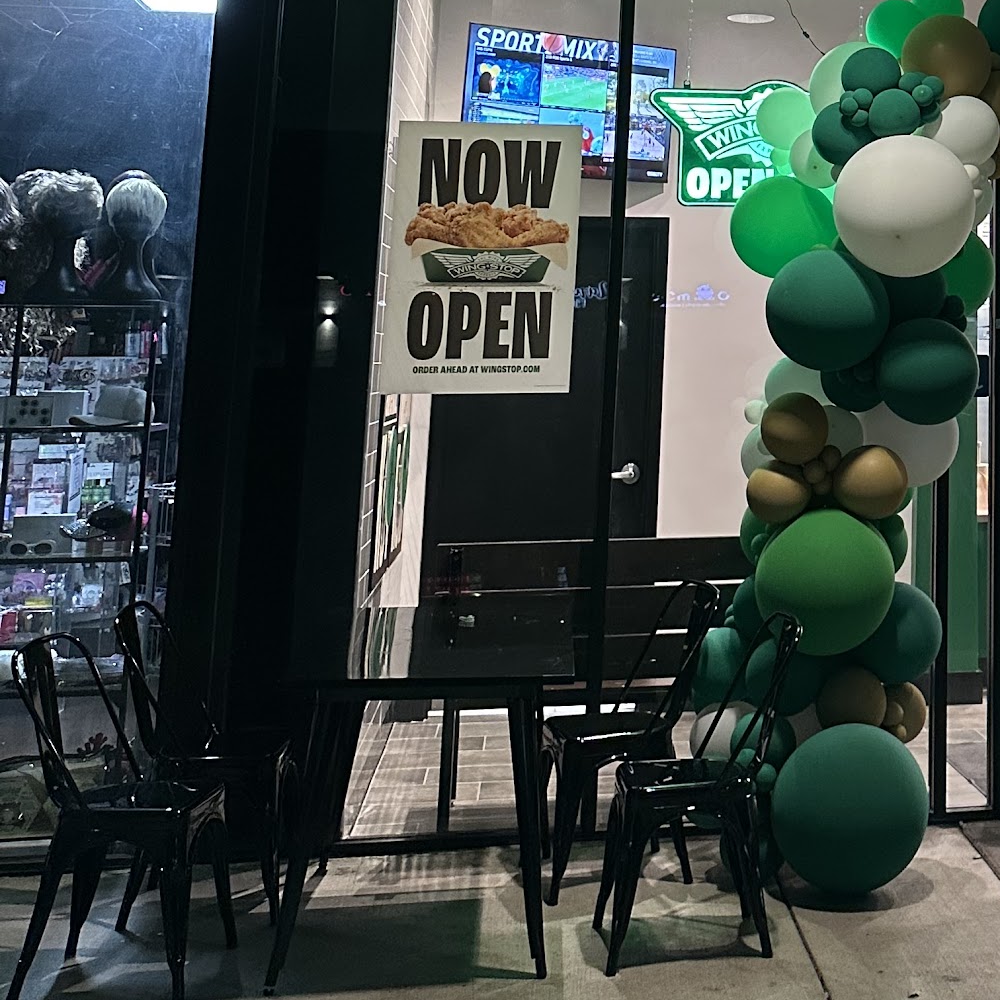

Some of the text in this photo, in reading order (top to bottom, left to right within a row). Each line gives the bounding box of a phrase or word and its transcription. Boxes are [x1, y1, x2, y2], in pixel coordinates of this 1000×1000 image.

[475, 27, 544, 53] SPORT
[561, 36, 598, 60] MIX
[706, 121, 760, 149] WIN
[418, 139, 561, 209] NOW
[407, 291, 552, 361] OPEN
[413, 366, 438, 374] ORDER
[440, 366, 467, 374] AHEAD
[481, 365, 540, 373] WINGSTOP.COM
